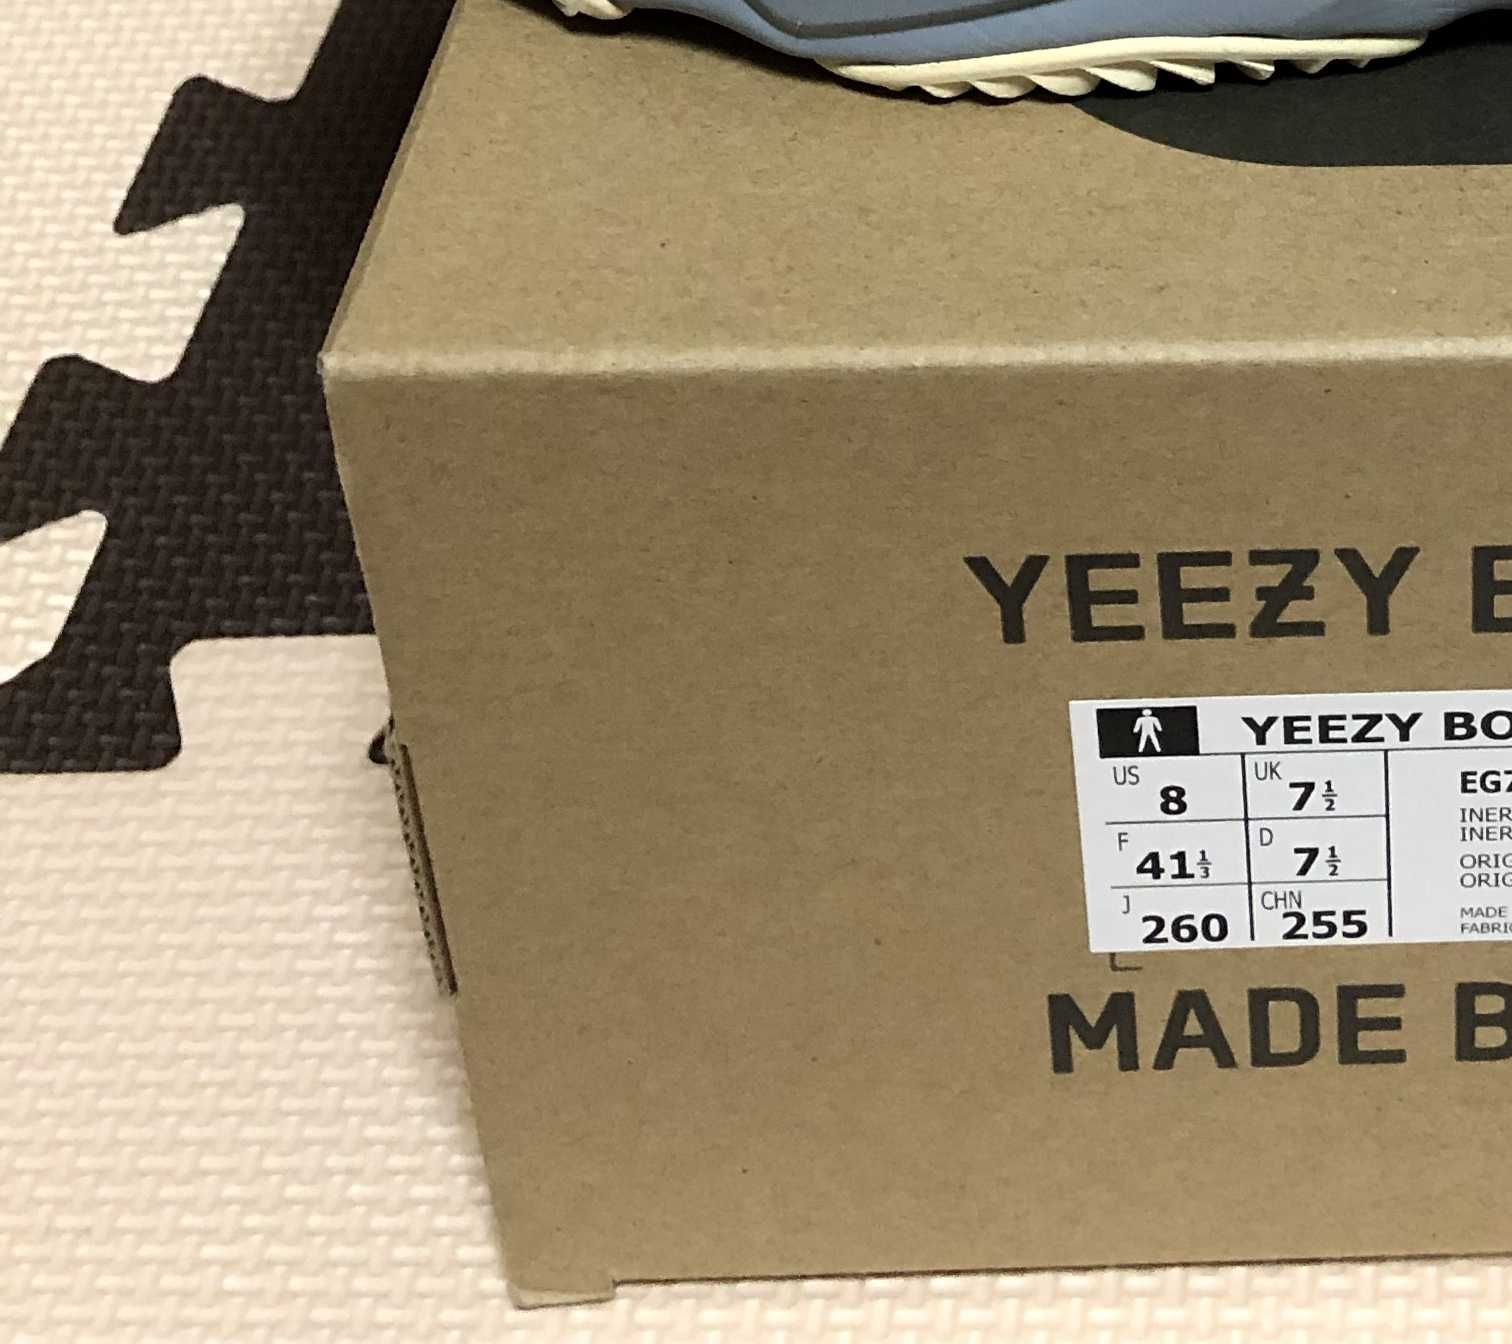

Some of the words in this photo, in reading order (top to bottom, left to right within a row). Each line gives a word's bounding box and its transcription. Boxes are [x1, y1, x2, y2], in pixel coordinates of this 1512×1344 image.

[963, 546, 1420, 644] YEEZY
[1241, 712, 1423, 745] YEEZY
[1113, 766, 1140, 785] US
[1254, 761, 1282, 780] UK
[1160, 785, 1187, 815] 8
[1117, 832, 1129, 851] F
[1259, 828, 1273, 846] D
[1122, 896, 1131, 914] J
[1261, 890, 1303, 910] CHN
[1460, 905, 1508, 918] MADE
[1142, 913, 1229, 944] 260
[1281, 910, 1369, 940] 255
[1047, 983, 1407, 1074] MADE
